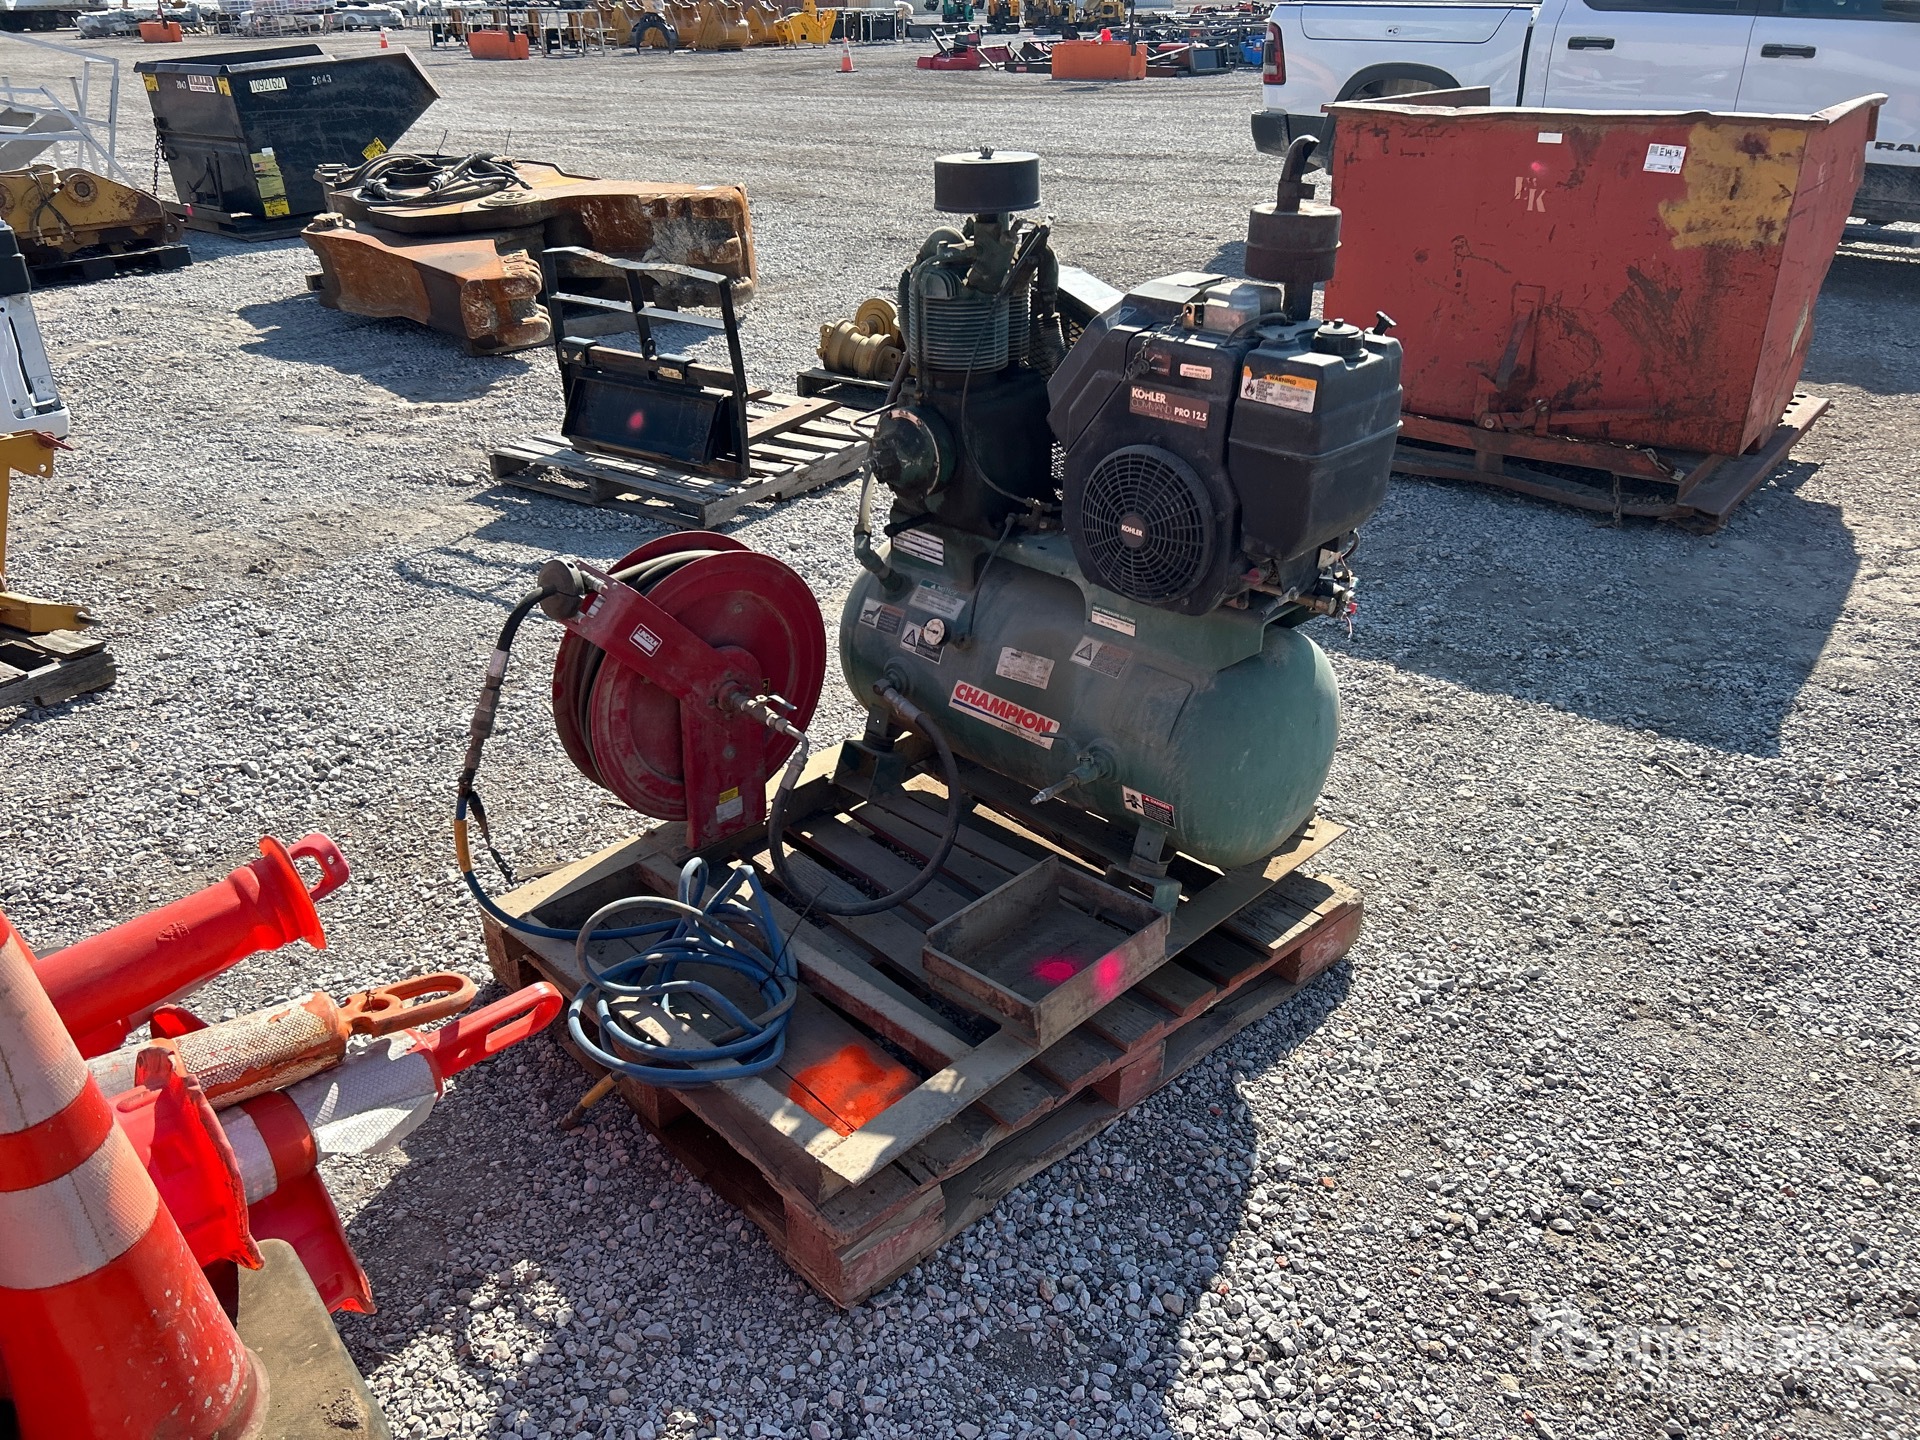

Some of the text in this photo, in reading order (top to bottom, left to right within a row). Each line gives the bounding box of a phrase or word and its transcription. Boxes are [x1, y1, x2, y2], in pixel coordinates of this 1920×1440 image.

[1875, 141, 1920, 152] RA
[1131, 386, 1167, 405] KOHLER
[1131, 398, 1173, 415] COMMAND
[1173, 406, 1191, 419] PRO
[1192, 410, 1208, 422] 12.5
[1121, 524, 1144, 538] KOHLER
[637, 628, 660, 648] LINCOLN
[955, 683, 1054, 734] CHAMPION
